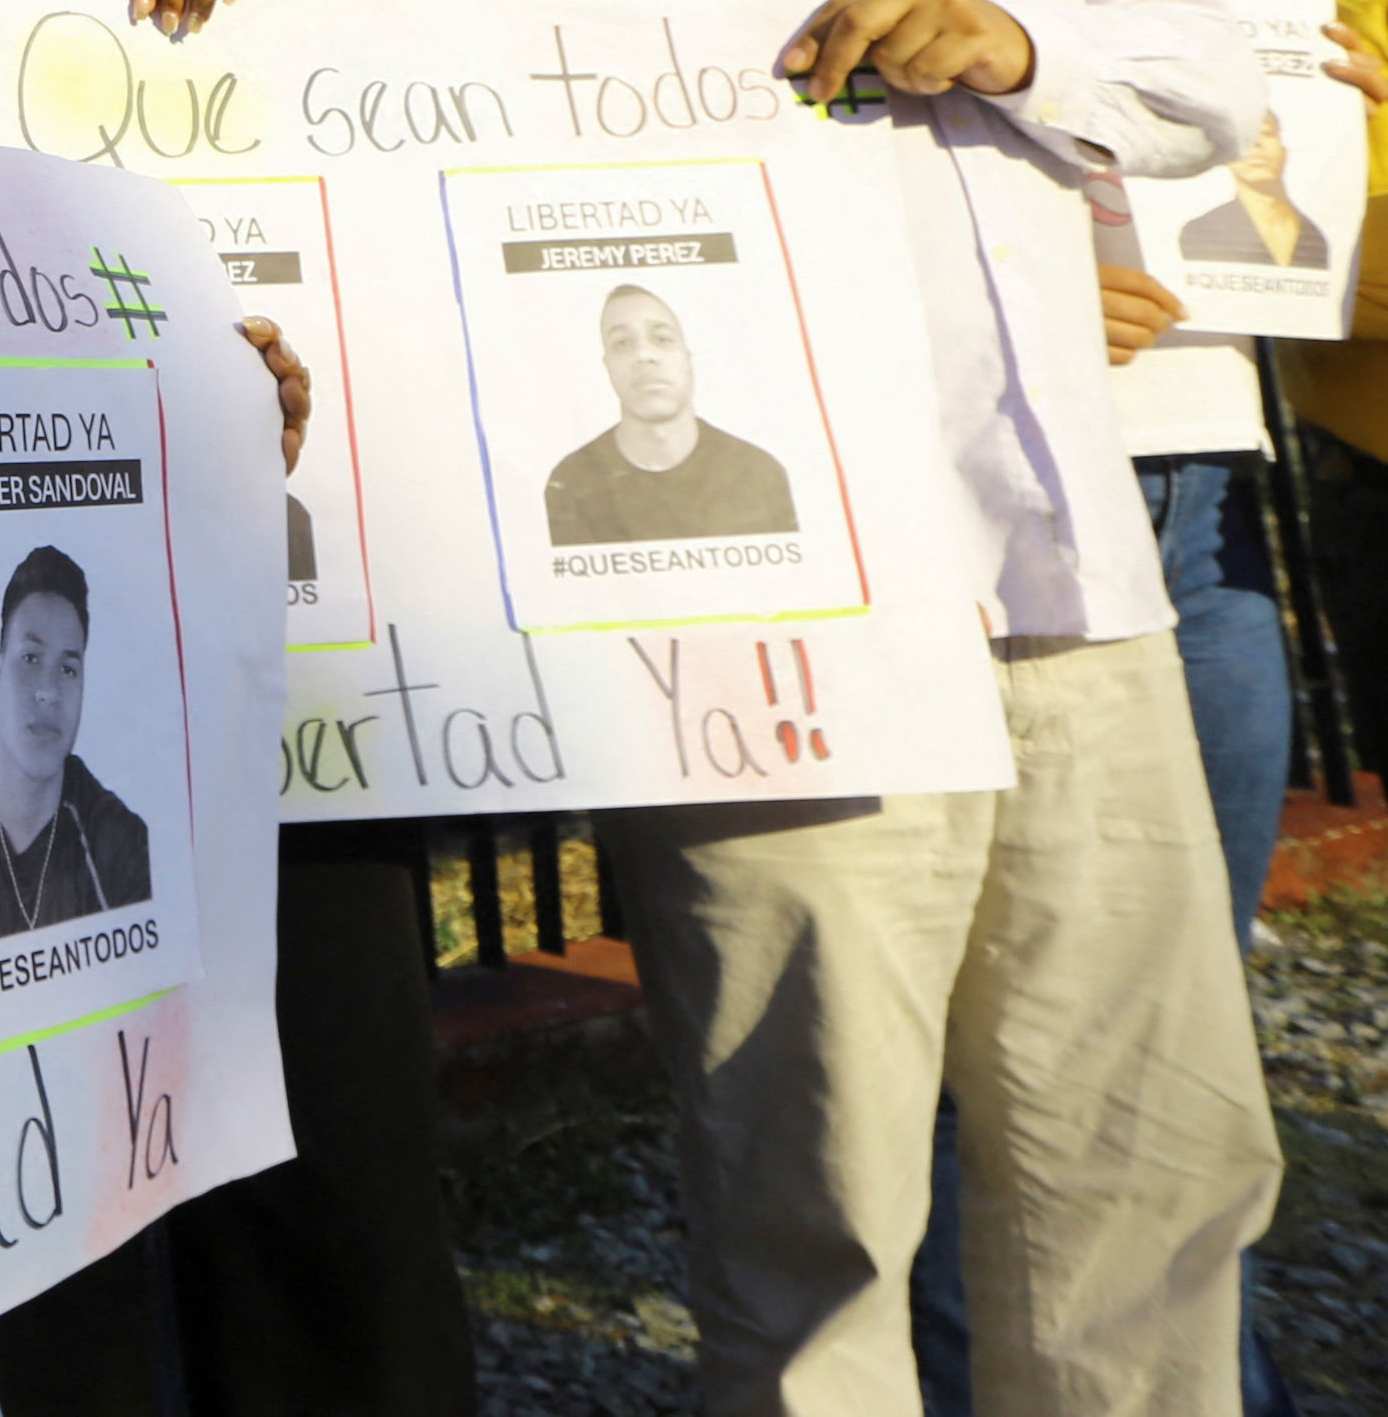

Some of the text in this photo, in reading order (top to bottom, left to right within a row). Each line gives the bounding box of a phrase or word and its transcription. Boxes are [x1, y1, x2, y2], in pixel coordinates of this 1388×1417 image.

[301, 67, 512, 155] sean
[507, 197, 714, 232] LIBERTAD YA
[540, 241, 705, 270] JEREMY PEREZ
[77, 413, 116, 452] YA
[28, 471, 136, 503] SANDOVAL
[552, 543, 803, 578] #QUESEANTODOS
